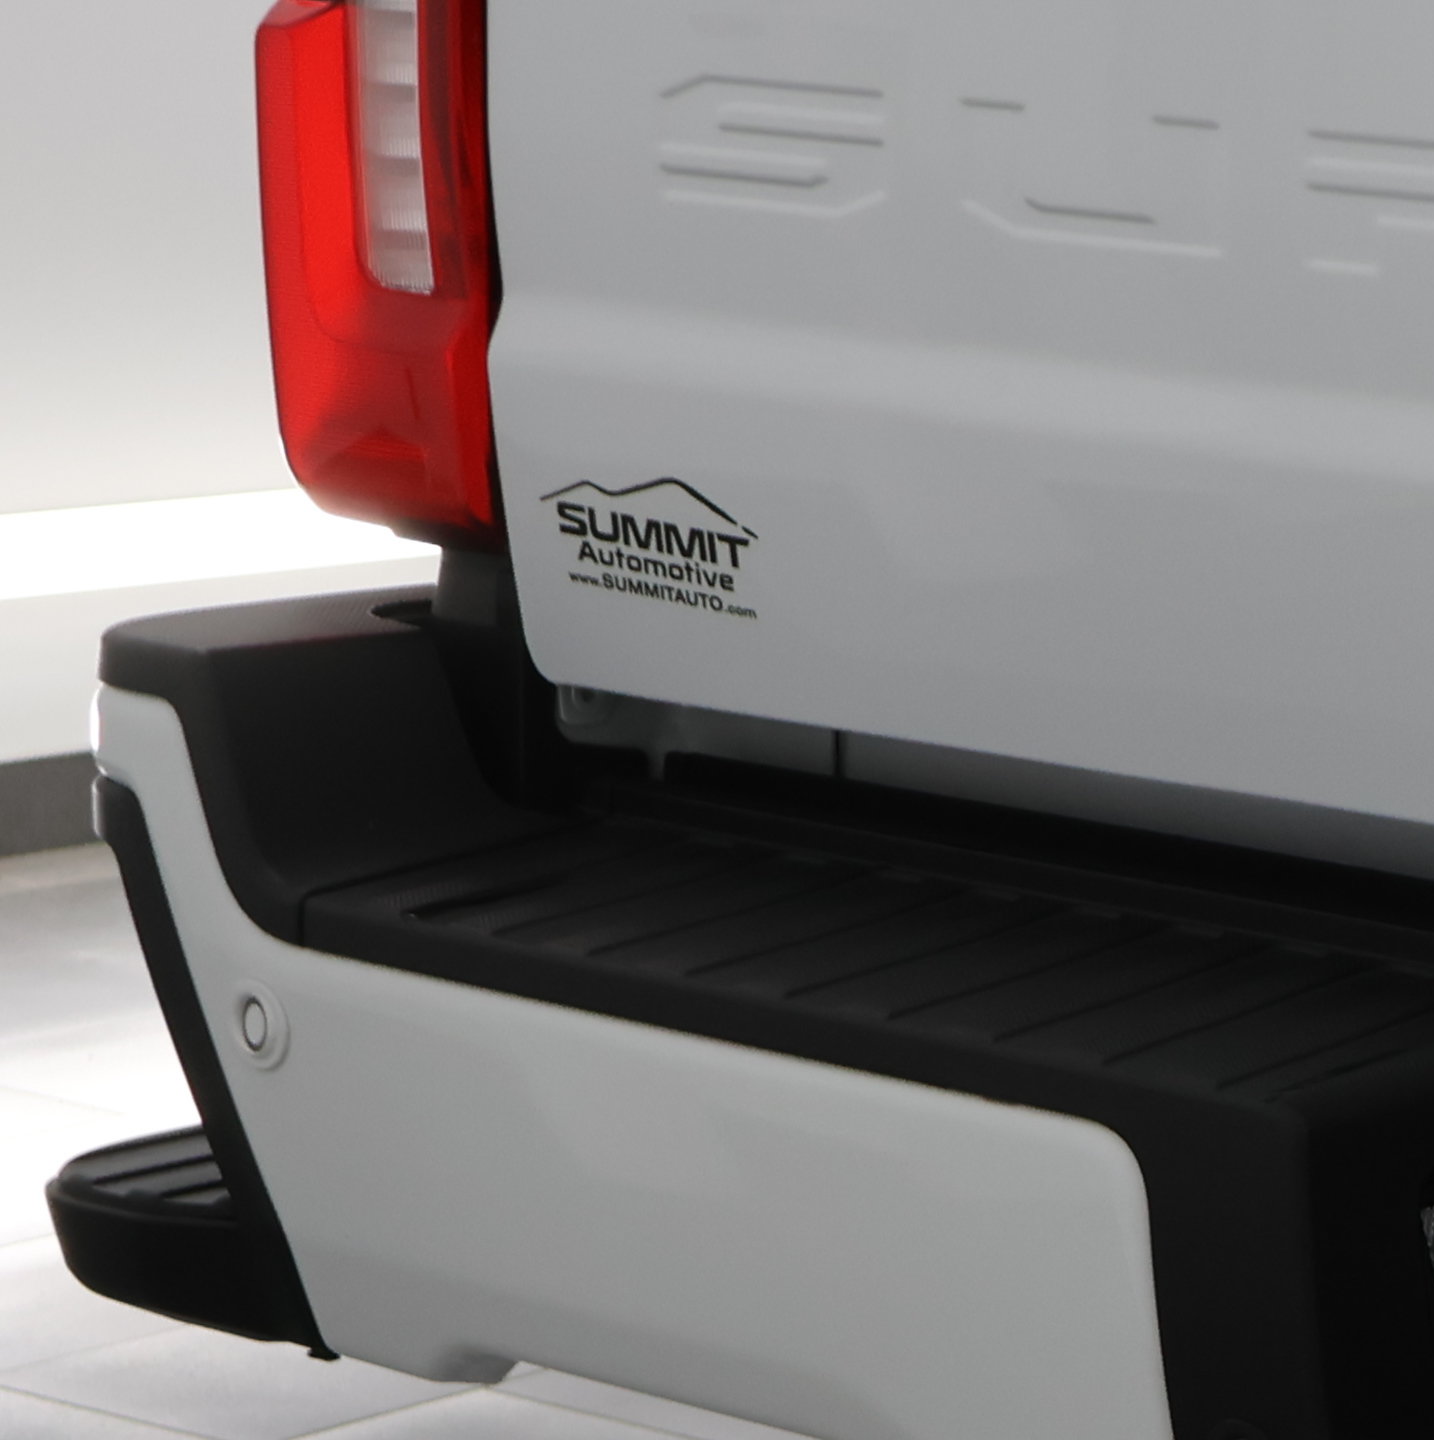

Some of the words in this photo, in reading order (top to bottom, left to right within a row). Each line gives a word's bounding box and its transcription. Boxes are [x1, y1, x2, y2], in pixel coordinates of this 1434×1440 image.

[556, 501, 750, 569] SUMMIT
[578, 540, 736, 593] Automotive
[568, 570, 758, 620] www.SUMMITAUTO.com
